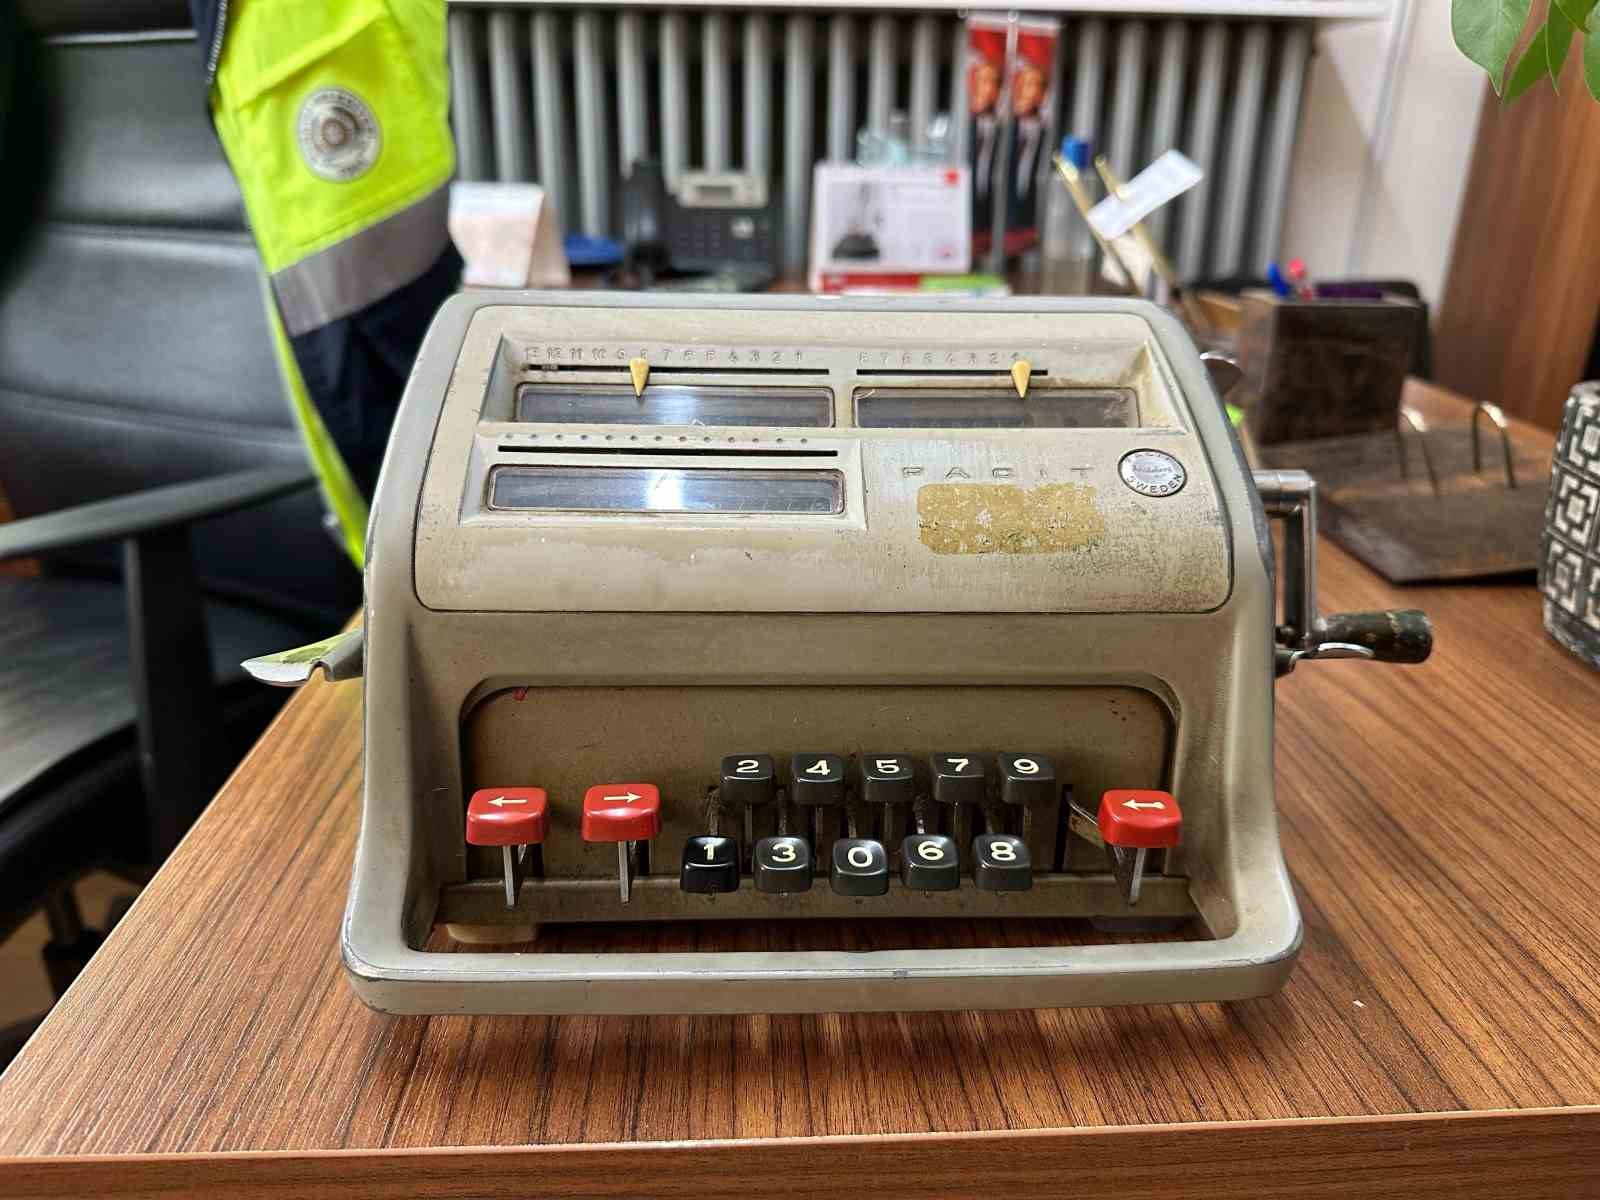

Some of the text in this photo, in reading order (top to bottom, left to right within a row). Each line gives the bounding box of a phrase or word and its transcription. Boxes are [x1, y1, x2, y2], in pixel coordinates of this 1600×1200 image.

[569, 347, 583, 360] 11
[903, 466, 1094, 479] FACIT
[1127, 473, 1182, 493] SWEDEN
[736, 758, 1039, 776] 2 4 5 7 9
[703, 840, 1018, 868] 1 3 0 6 8
